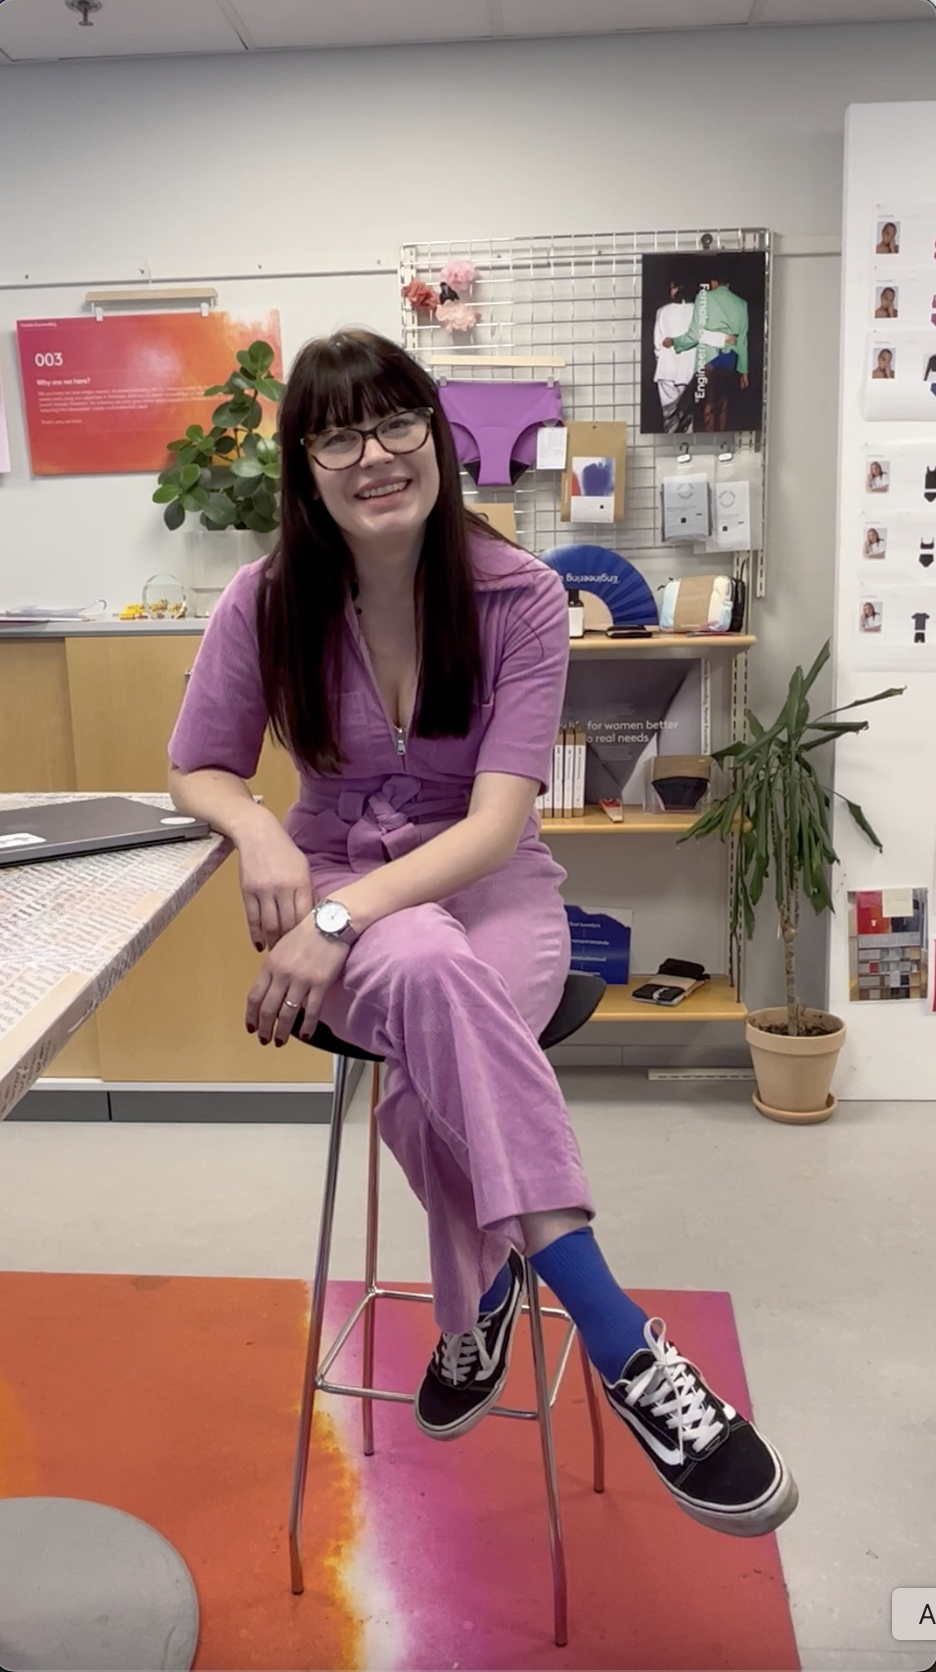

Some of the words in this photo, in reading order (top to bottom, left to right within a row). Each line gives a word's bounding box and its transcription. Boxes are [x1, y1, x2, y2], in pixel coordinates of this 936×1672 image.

[34, 352, 64, 367] 003
[36, 379, 51, 387] Why
[586, 720, 602, 731] for
[604, 722, 644, 731] women
[645, 720, 679, 731] better
[595, 733, 616, 744] real
[617, 733, 649, 744] needs
